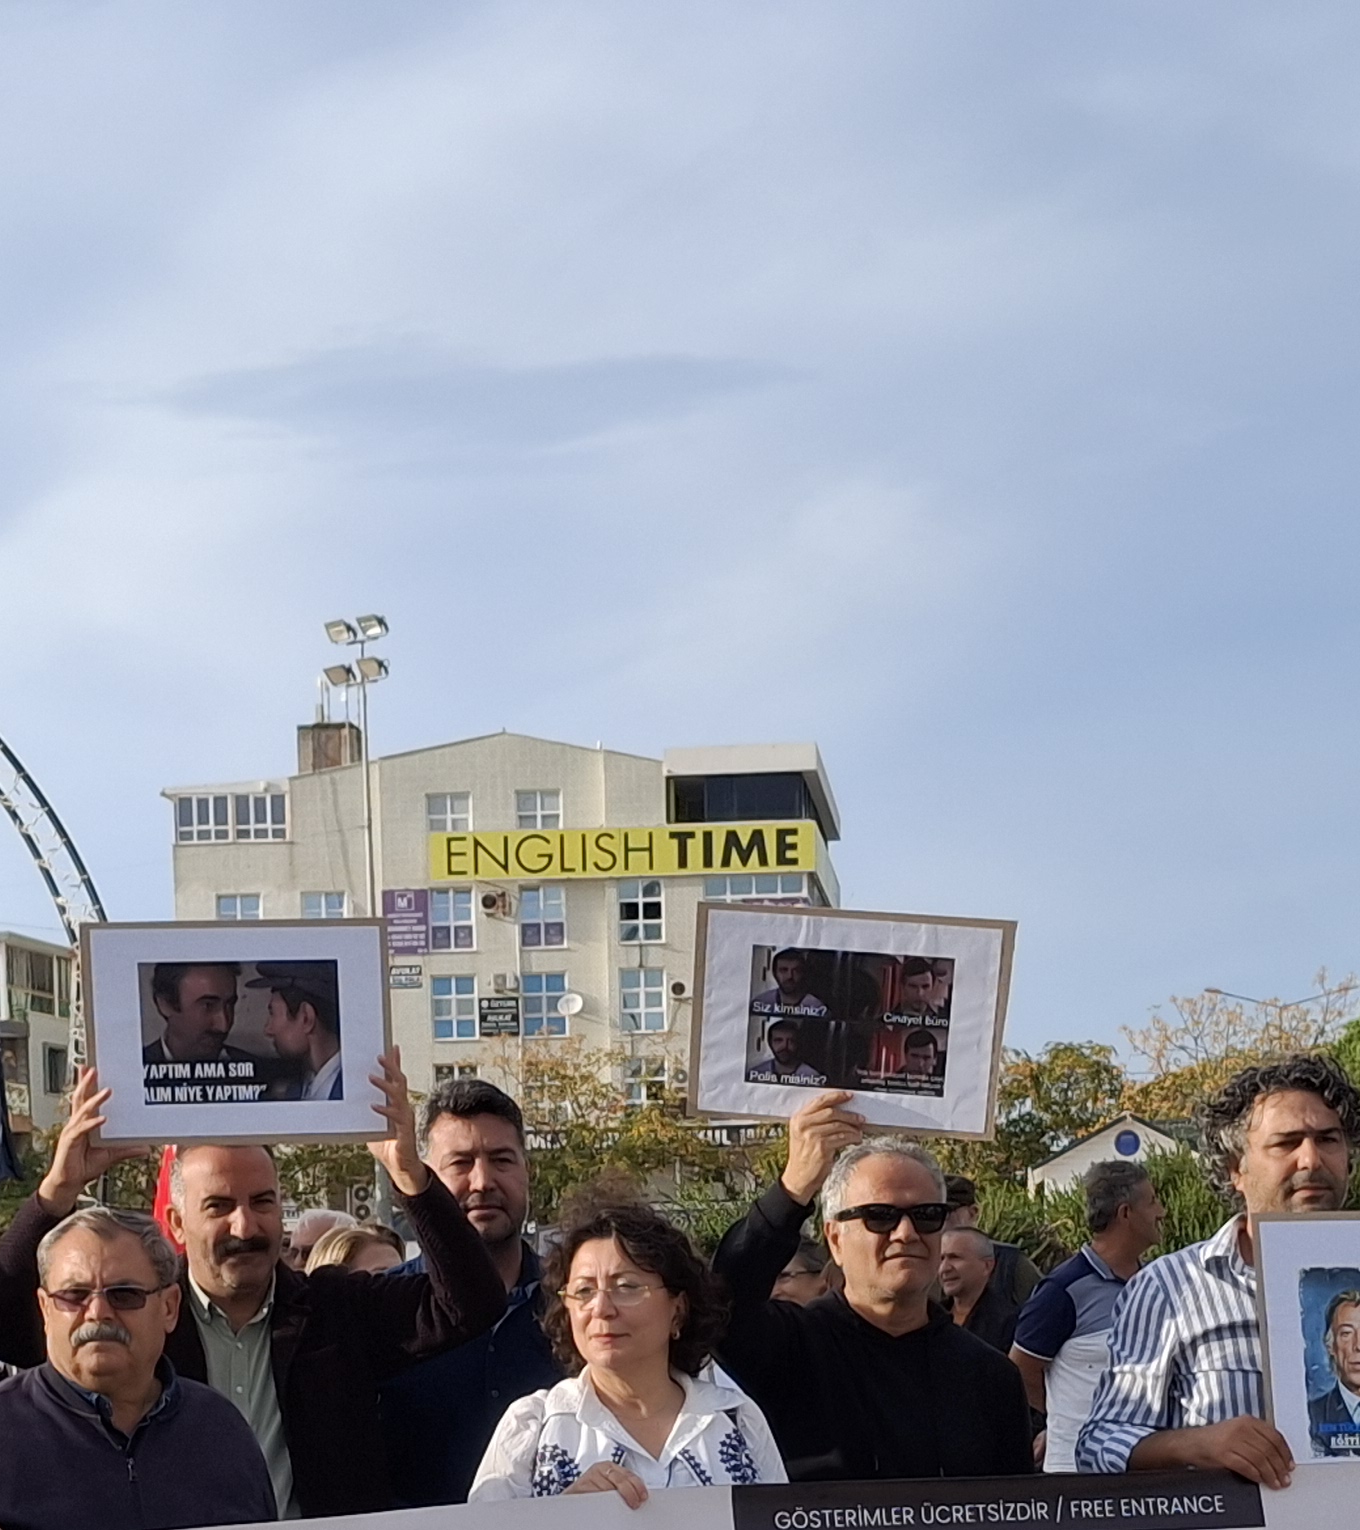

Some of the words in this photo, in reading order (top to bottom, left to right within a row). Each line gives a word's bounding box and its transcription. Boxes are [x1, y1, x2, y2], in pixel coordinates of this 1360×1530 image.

[446, 831, 653, 876] ENGLISH
[669, 827, 799, 868] TIME
[753, 1002, 772, 1013] Siz
[773, 1002, 827, 1017] kimsiniz?
[143, 1062, 191, 1080] YAPTIM
[195, 1062, 226, 1079] AMA
[229, 1061, 254, 1078] SOR
[174, 1082, 203, 1102] NİYE
[774, 1505, 915, 1530] GÖSTERİMLER
[921, 1498, 1049, 1525] ÜCRETSİZDİR
[1055, 1495, 1064, 1523] /
[1070, 1499, 1115, 1520] FREE
[1120, 1495, 1226, 1518] ENTRANCE
